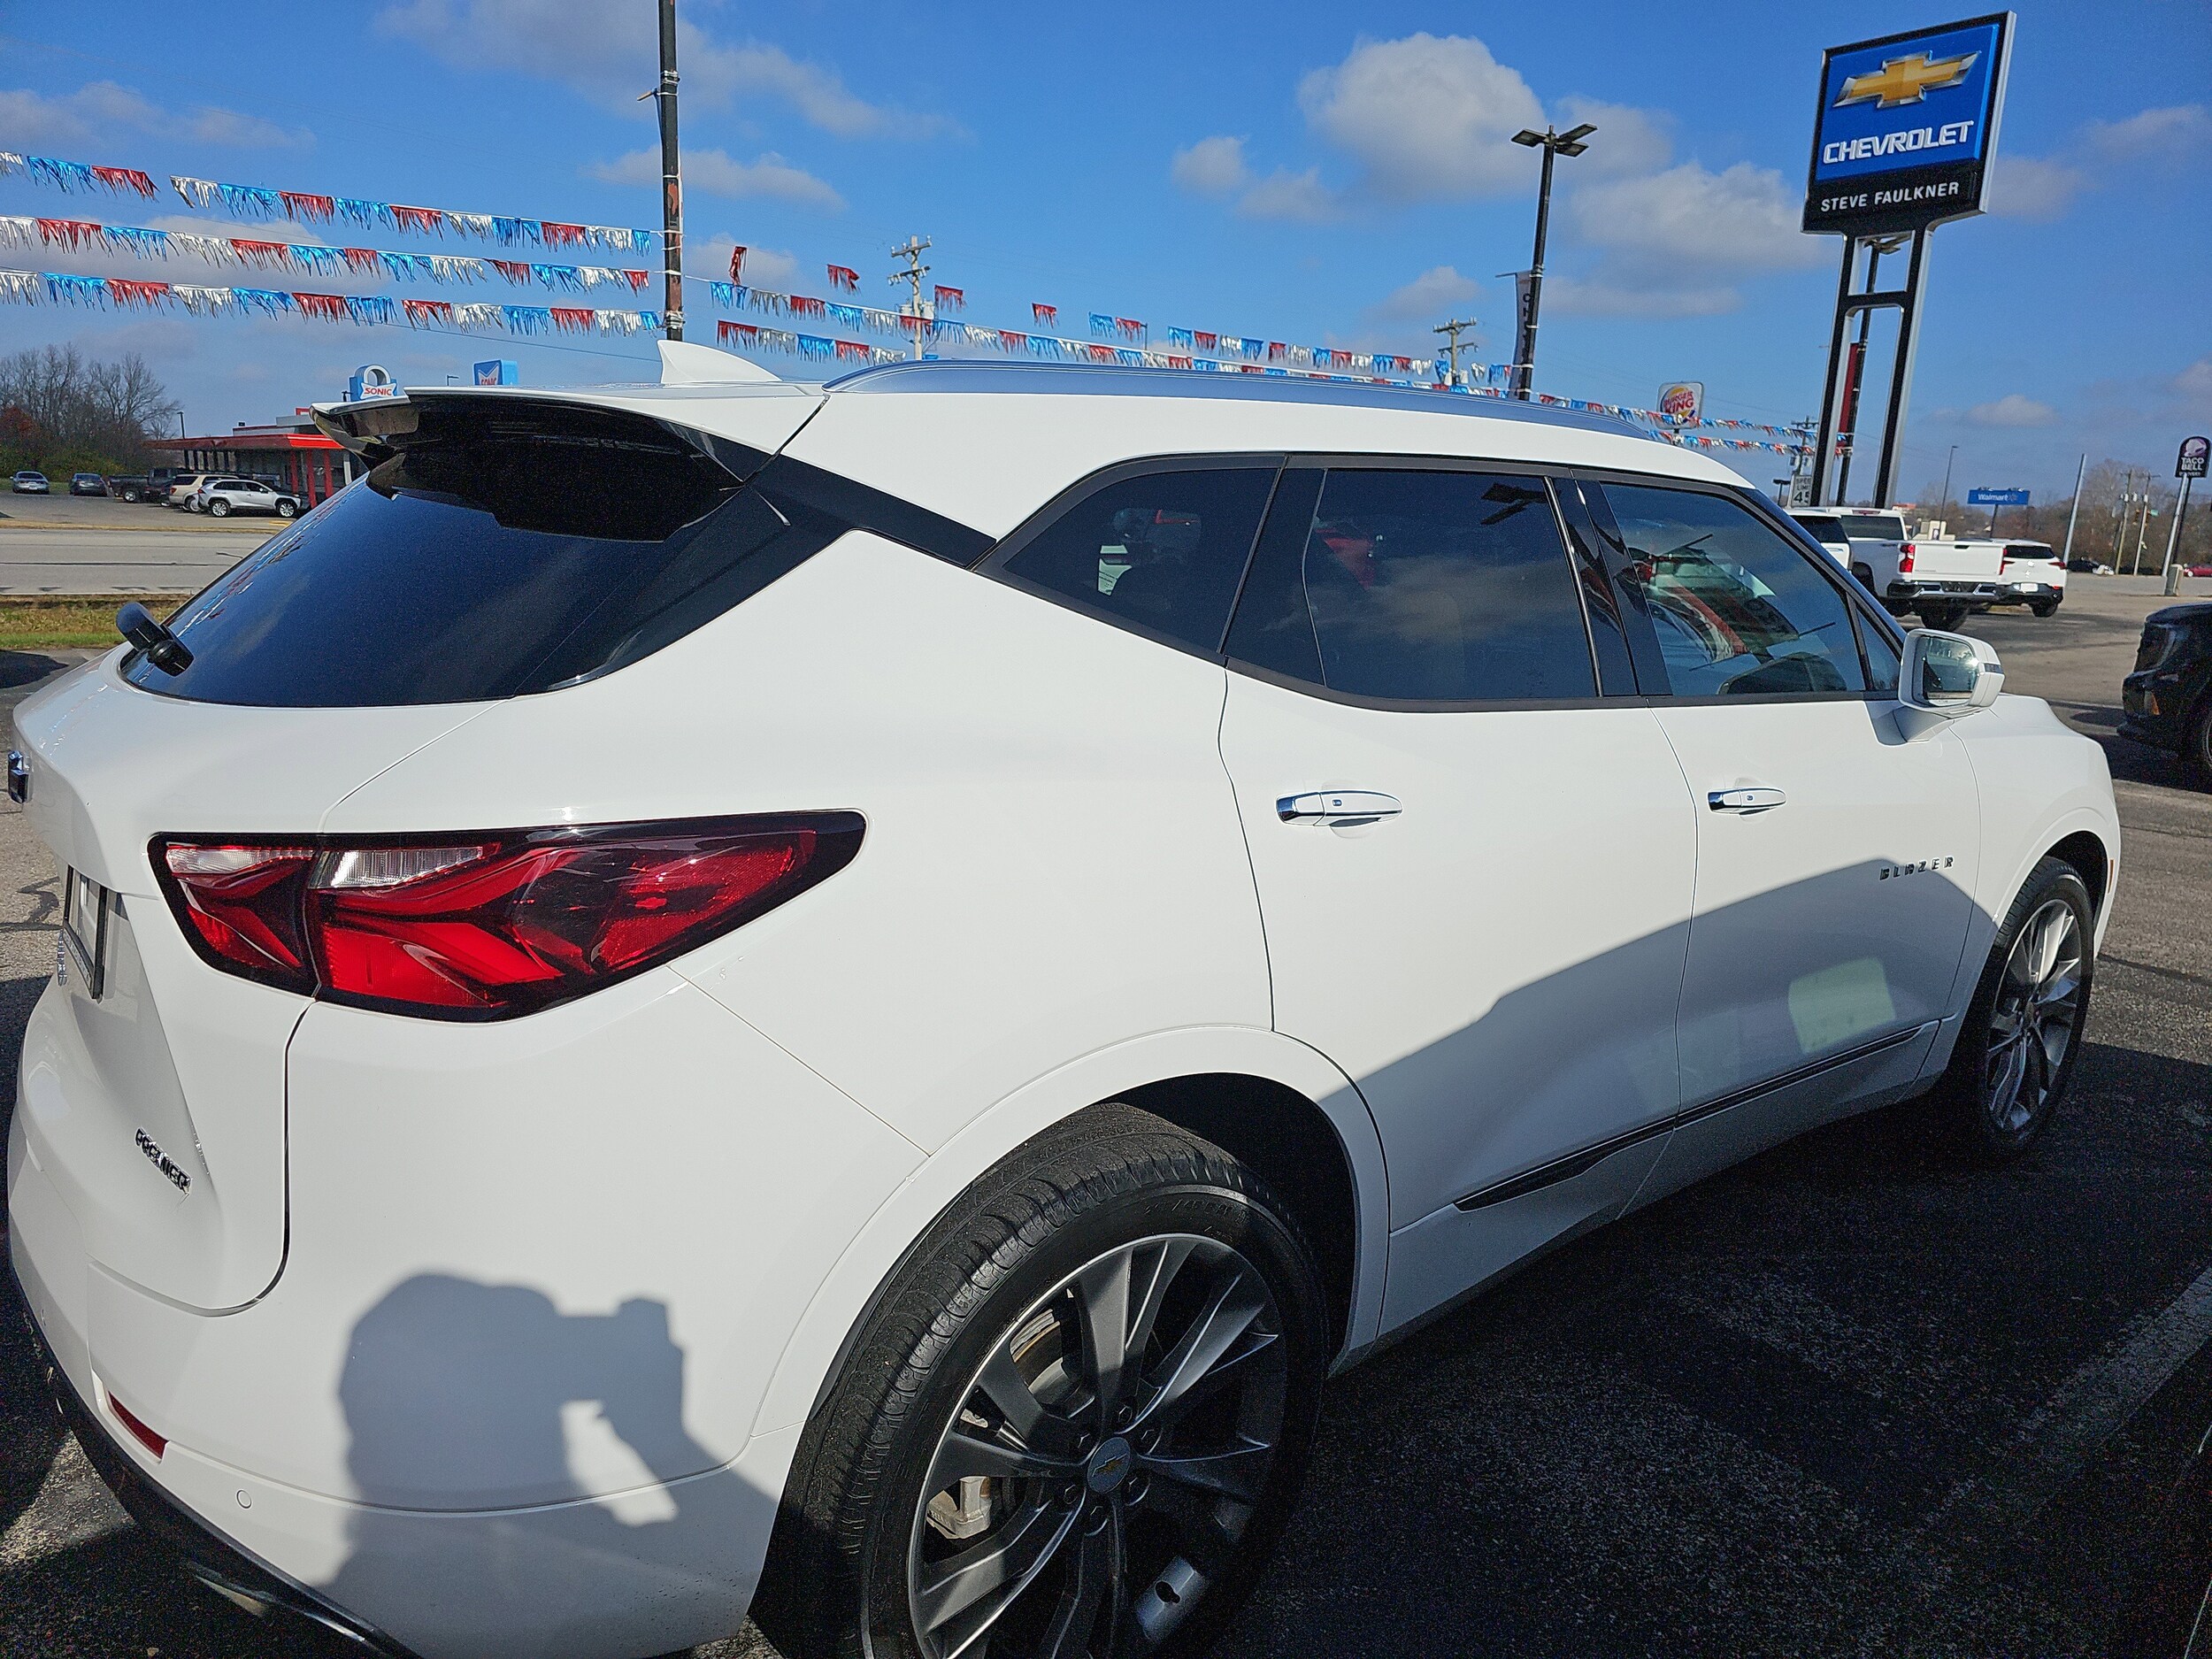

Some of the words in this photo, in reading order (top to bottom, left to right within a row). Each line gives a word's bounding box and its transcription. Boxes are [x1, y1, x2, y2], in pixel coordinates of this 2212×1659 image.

[1823, 120, 1974, 164] CHEVROLET
[1820, 193, 1868, 211] STEVE
[1874, 181, 1960, 204] FAULKNER
[364, 387, 392, 396] SONIC
[1664, 398, 1694, 413] KING
[1879, 856, 1954, 880] BLAZER
[134, 1127, 191, 1195] PREMIER
